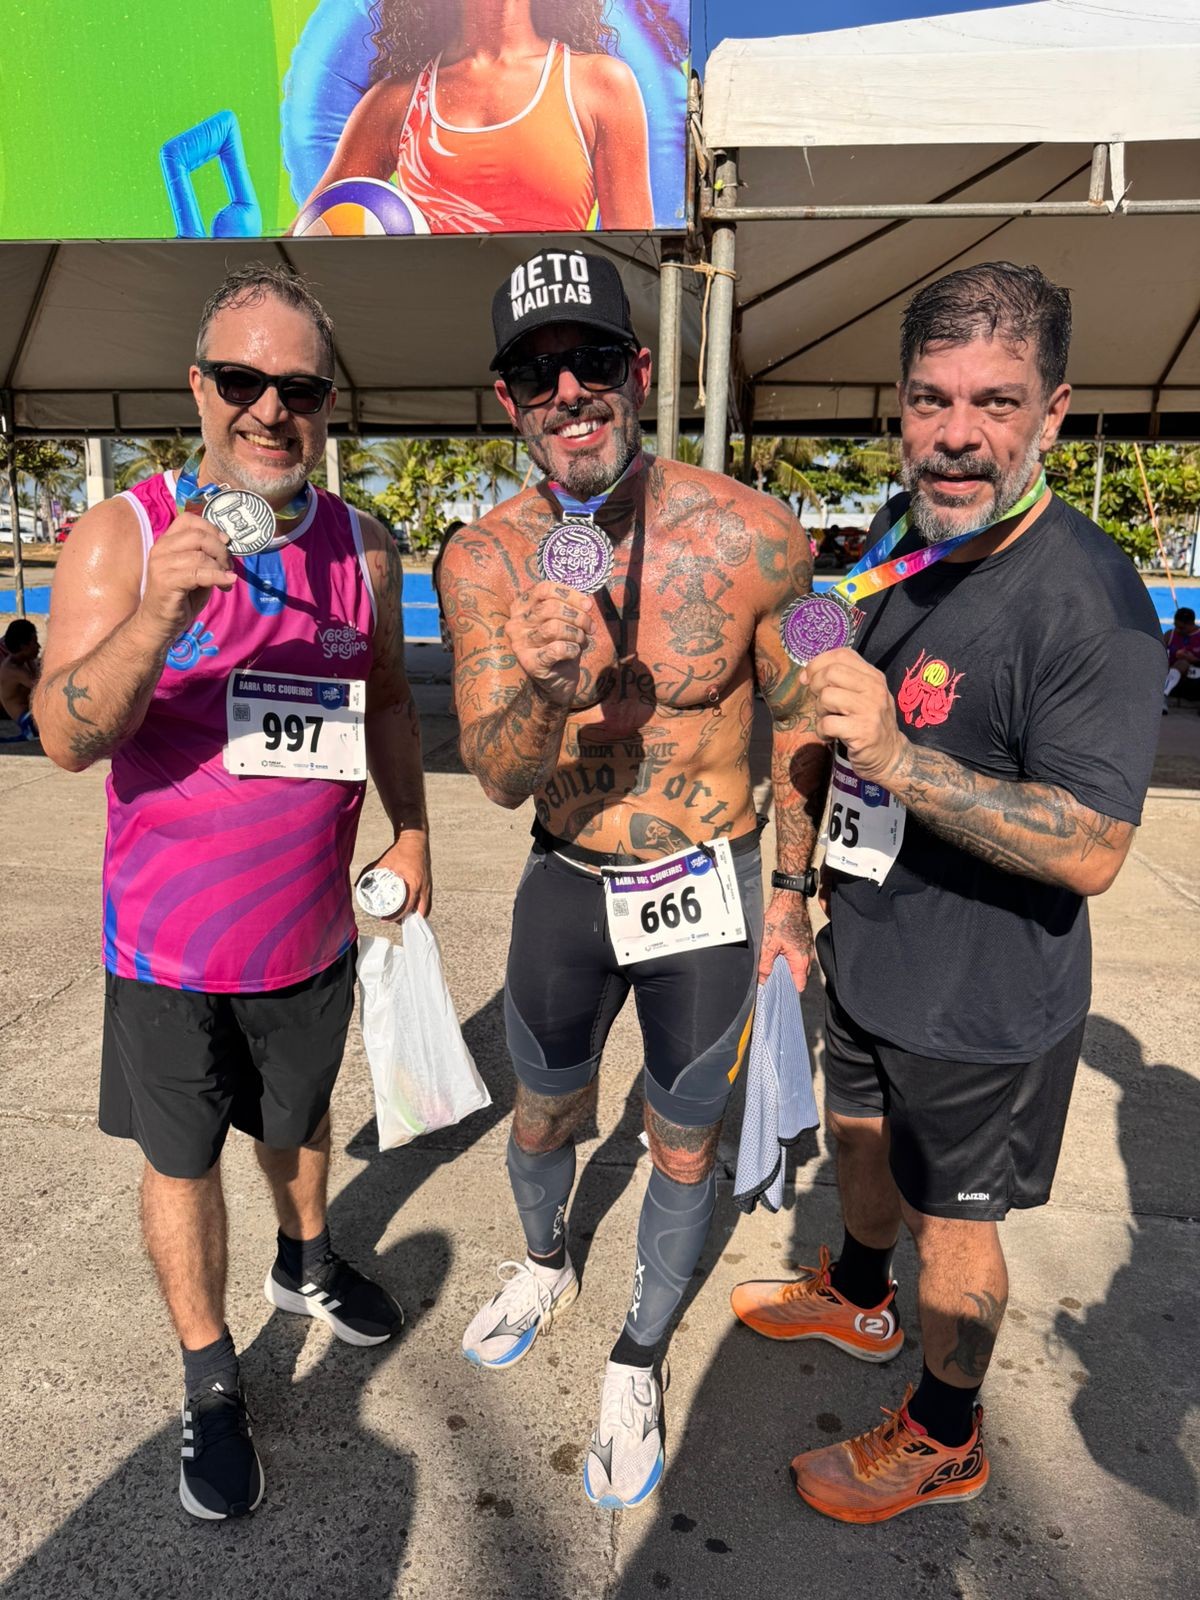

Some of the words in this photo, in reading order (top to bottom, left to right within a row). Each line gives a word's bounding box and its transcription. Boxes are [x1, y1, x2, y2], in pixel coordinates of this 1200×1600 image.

[510, 283, 592, 321] NAUTAS
[239, 680, 261, 691] BARRA
[263, 683, 276, 693] DOS
[278, 685, 313, 697] COQUEIROS
[262, 711, 324, 753] 997
[829, 802, 860, 848] 65
[614, 876, 636, 886] BARRA
[636, 875, 650, 885] DOS
[649, 864, 683, 884] COQUEIROS
[640, 885, 702, 934] 666
[957, 1191, 990, 1202] KAIZEN
